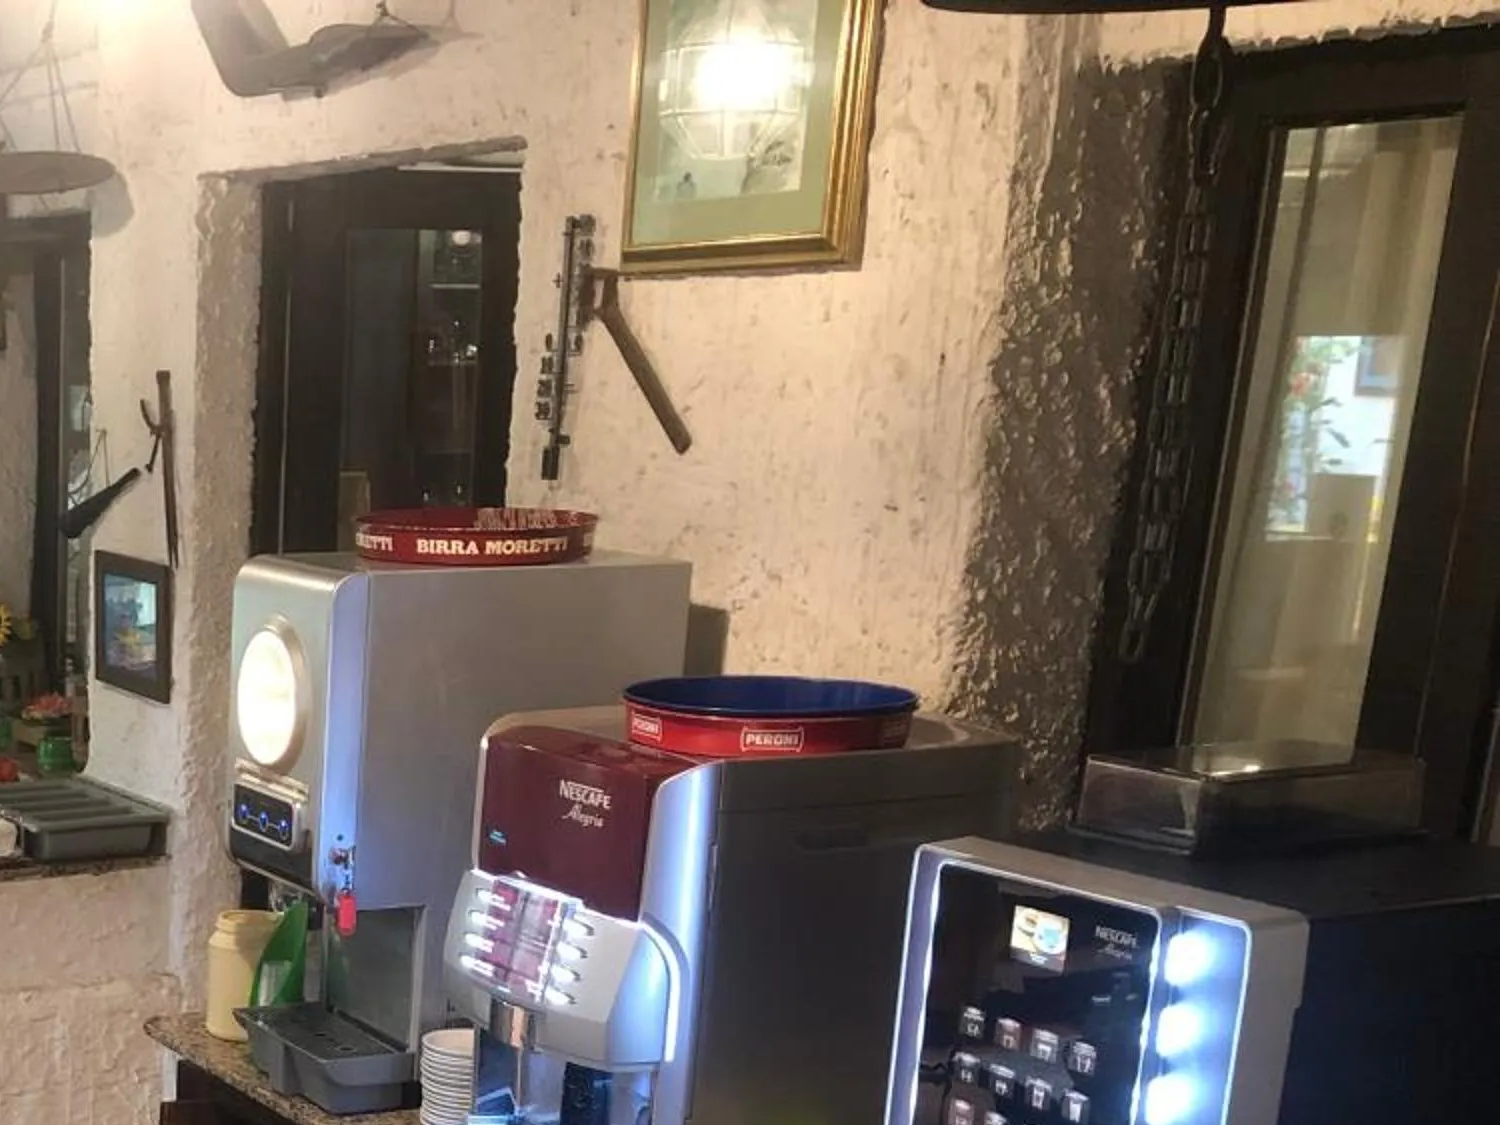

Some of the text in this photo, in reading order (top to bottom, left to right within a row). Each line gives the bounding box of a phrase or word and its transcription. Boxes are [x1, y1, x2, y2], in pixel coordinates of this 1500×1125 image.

[416, 538, 479, 555] BIRRA
[485, 536, 568, 555] MORETTI
[745, 733, 799, 745] PERONI
